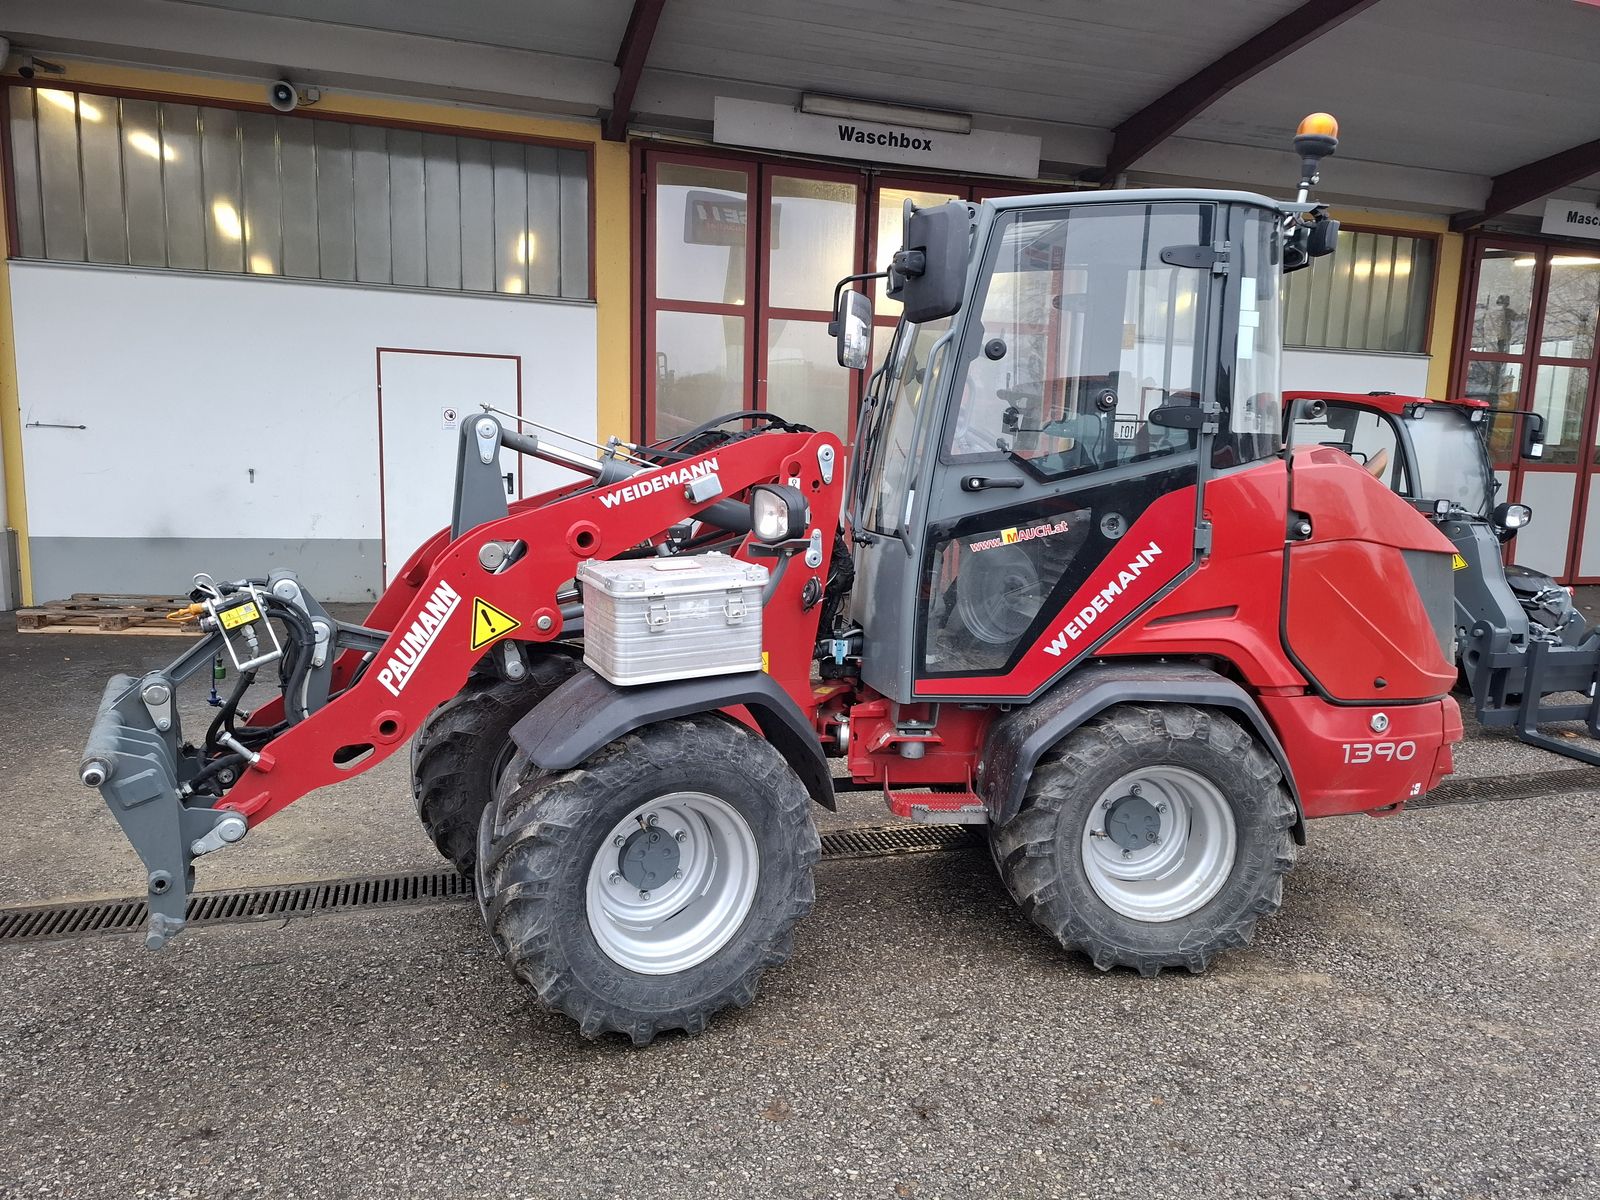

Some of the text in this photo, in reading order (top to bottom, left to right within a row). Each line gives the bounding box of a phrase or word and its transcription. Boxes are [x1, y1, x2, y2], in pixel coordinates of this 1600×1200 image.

[838, 125, 932, 151] Waschbox
[1566, 210, 1600, 226] Masc
[598, 457, 720, 509] WEIDEMANN
[969, 520, 1069, 553] www.MAUCH.at
[1042, 541, 1163, 657] WEIDEMANN
[376, 579, 459, 698] PAUMANN
[1342, 740, 1417, 764] 1390
